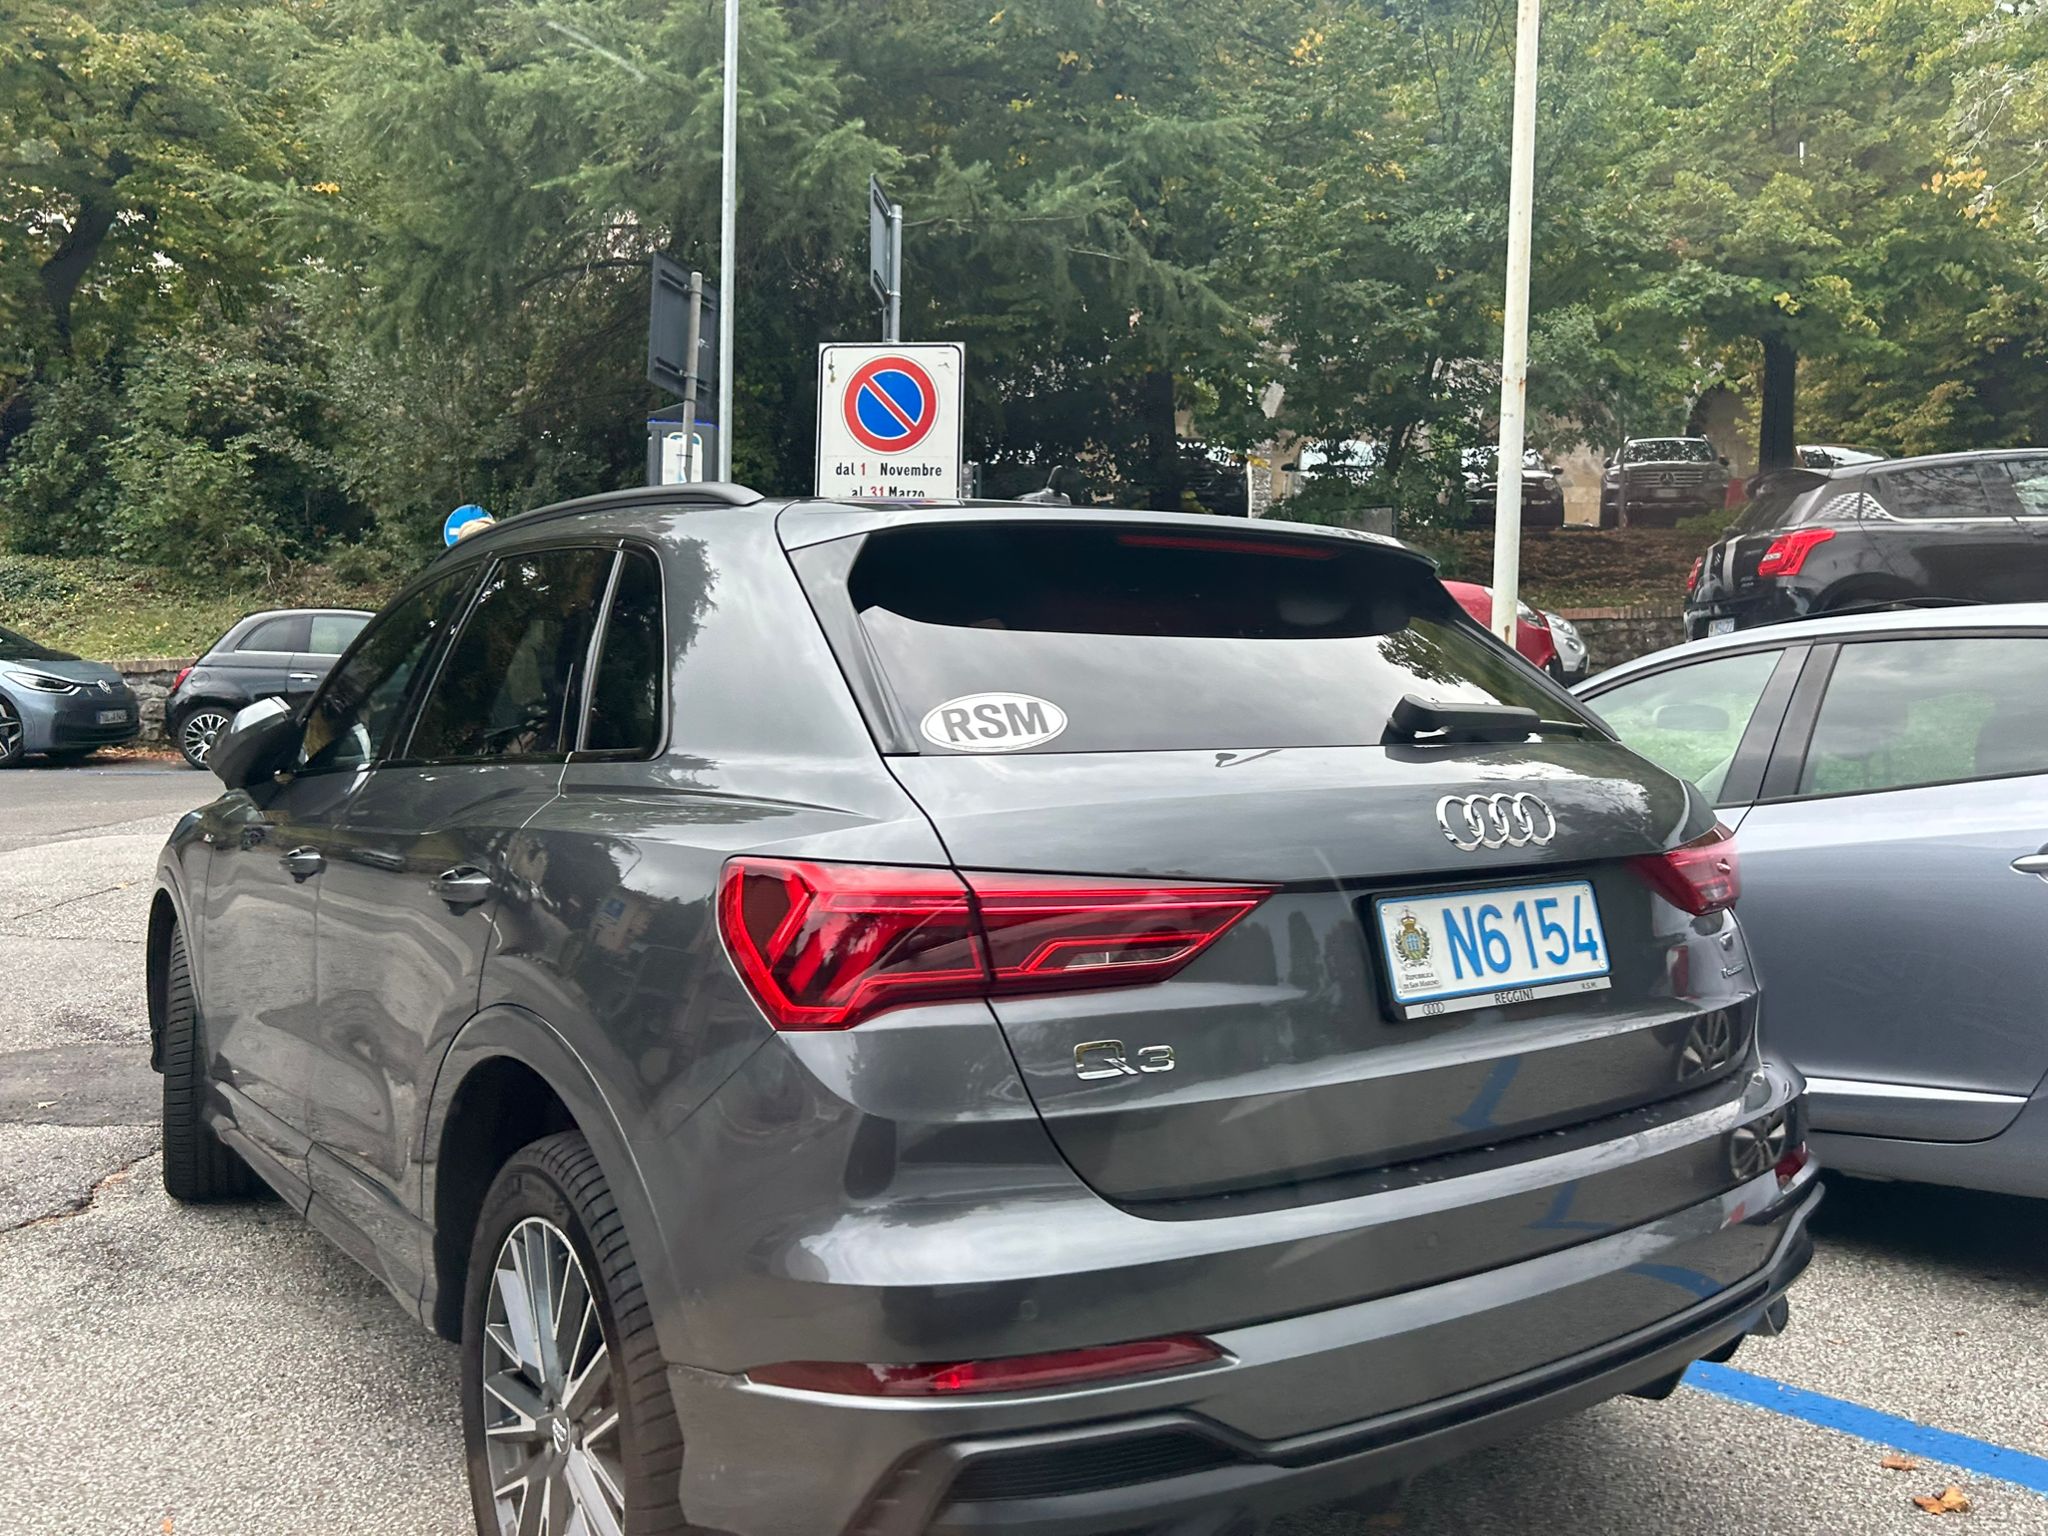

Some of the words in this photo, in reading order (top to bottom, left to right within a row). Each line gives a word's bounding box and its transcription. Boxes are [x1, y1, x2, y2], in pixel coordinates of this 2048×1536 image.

[835, 463, 855, 476] dal
[860, 463, 866, 476] 1
[880, 463, 942, 476] Novembre
[851, 486, 863, 497] al
[870, 486, 884, 497] 31
[889, 486, 925, 497] Marzo
[941, 702, 1050, 742] RSM
[1442, 895, 1598, 980] N6154
[1494, 988, 1534, 1005] REGGINI
[1073, 1039, 1176, 1080] Q3
